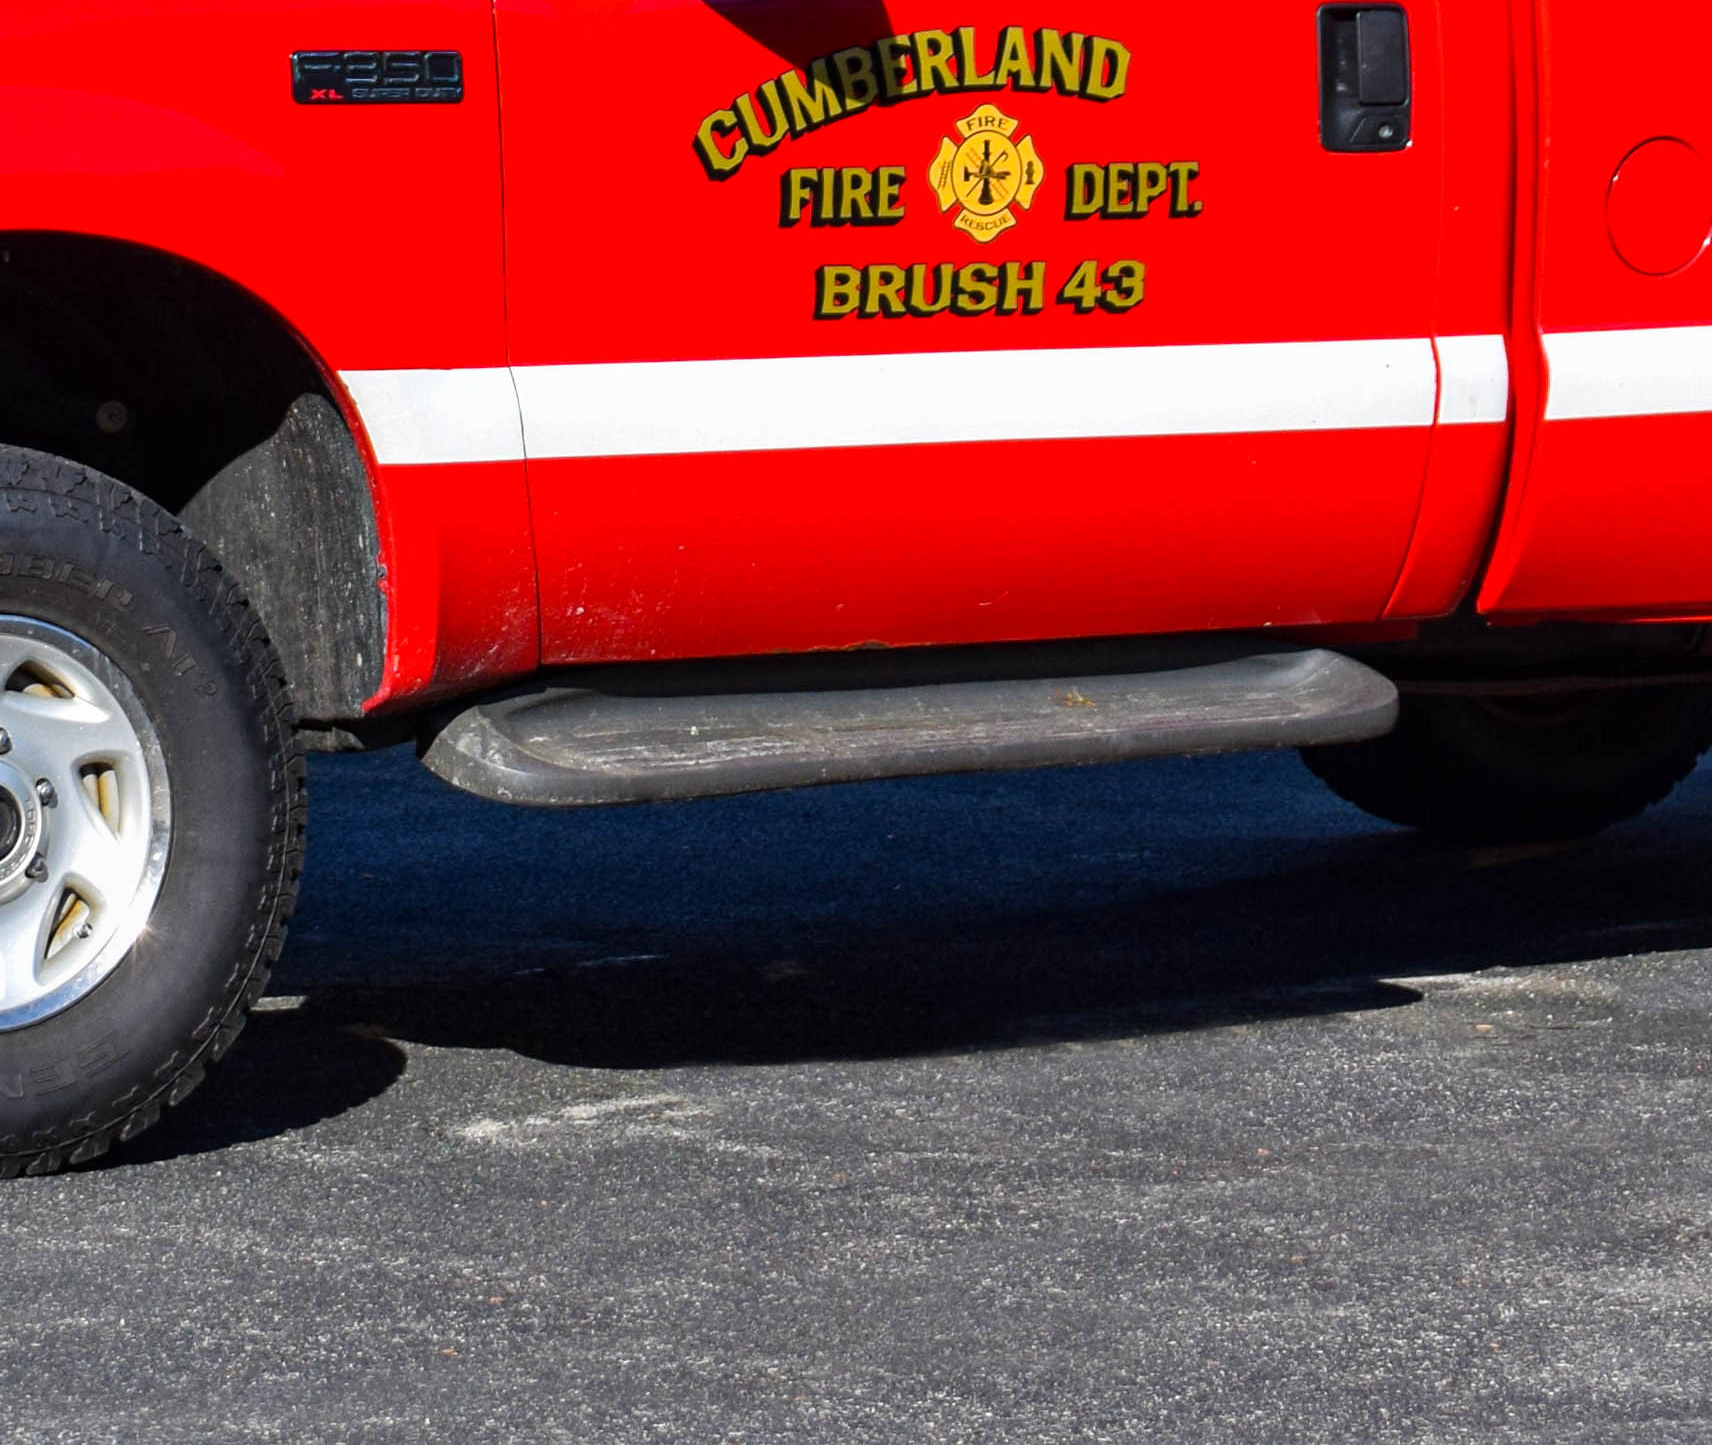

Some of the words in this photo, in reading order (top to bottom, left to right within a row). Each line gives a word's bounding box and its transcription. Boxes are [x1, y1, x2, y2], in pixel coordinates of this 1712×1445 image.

[309, 88, 344, 100] XL
[693, 26, 1132, 181] CUMBERLAND
[966, 115, 1009, 131] FIRE
[778, 164, 907, 228] FIRE
[1064, 160, 1204, 220] DEPT.
[960, 215, 1009, 231] RESCUE
[813, 261, 1047, 320] BRUSH
[1057, 259, 1146, 316] 43
